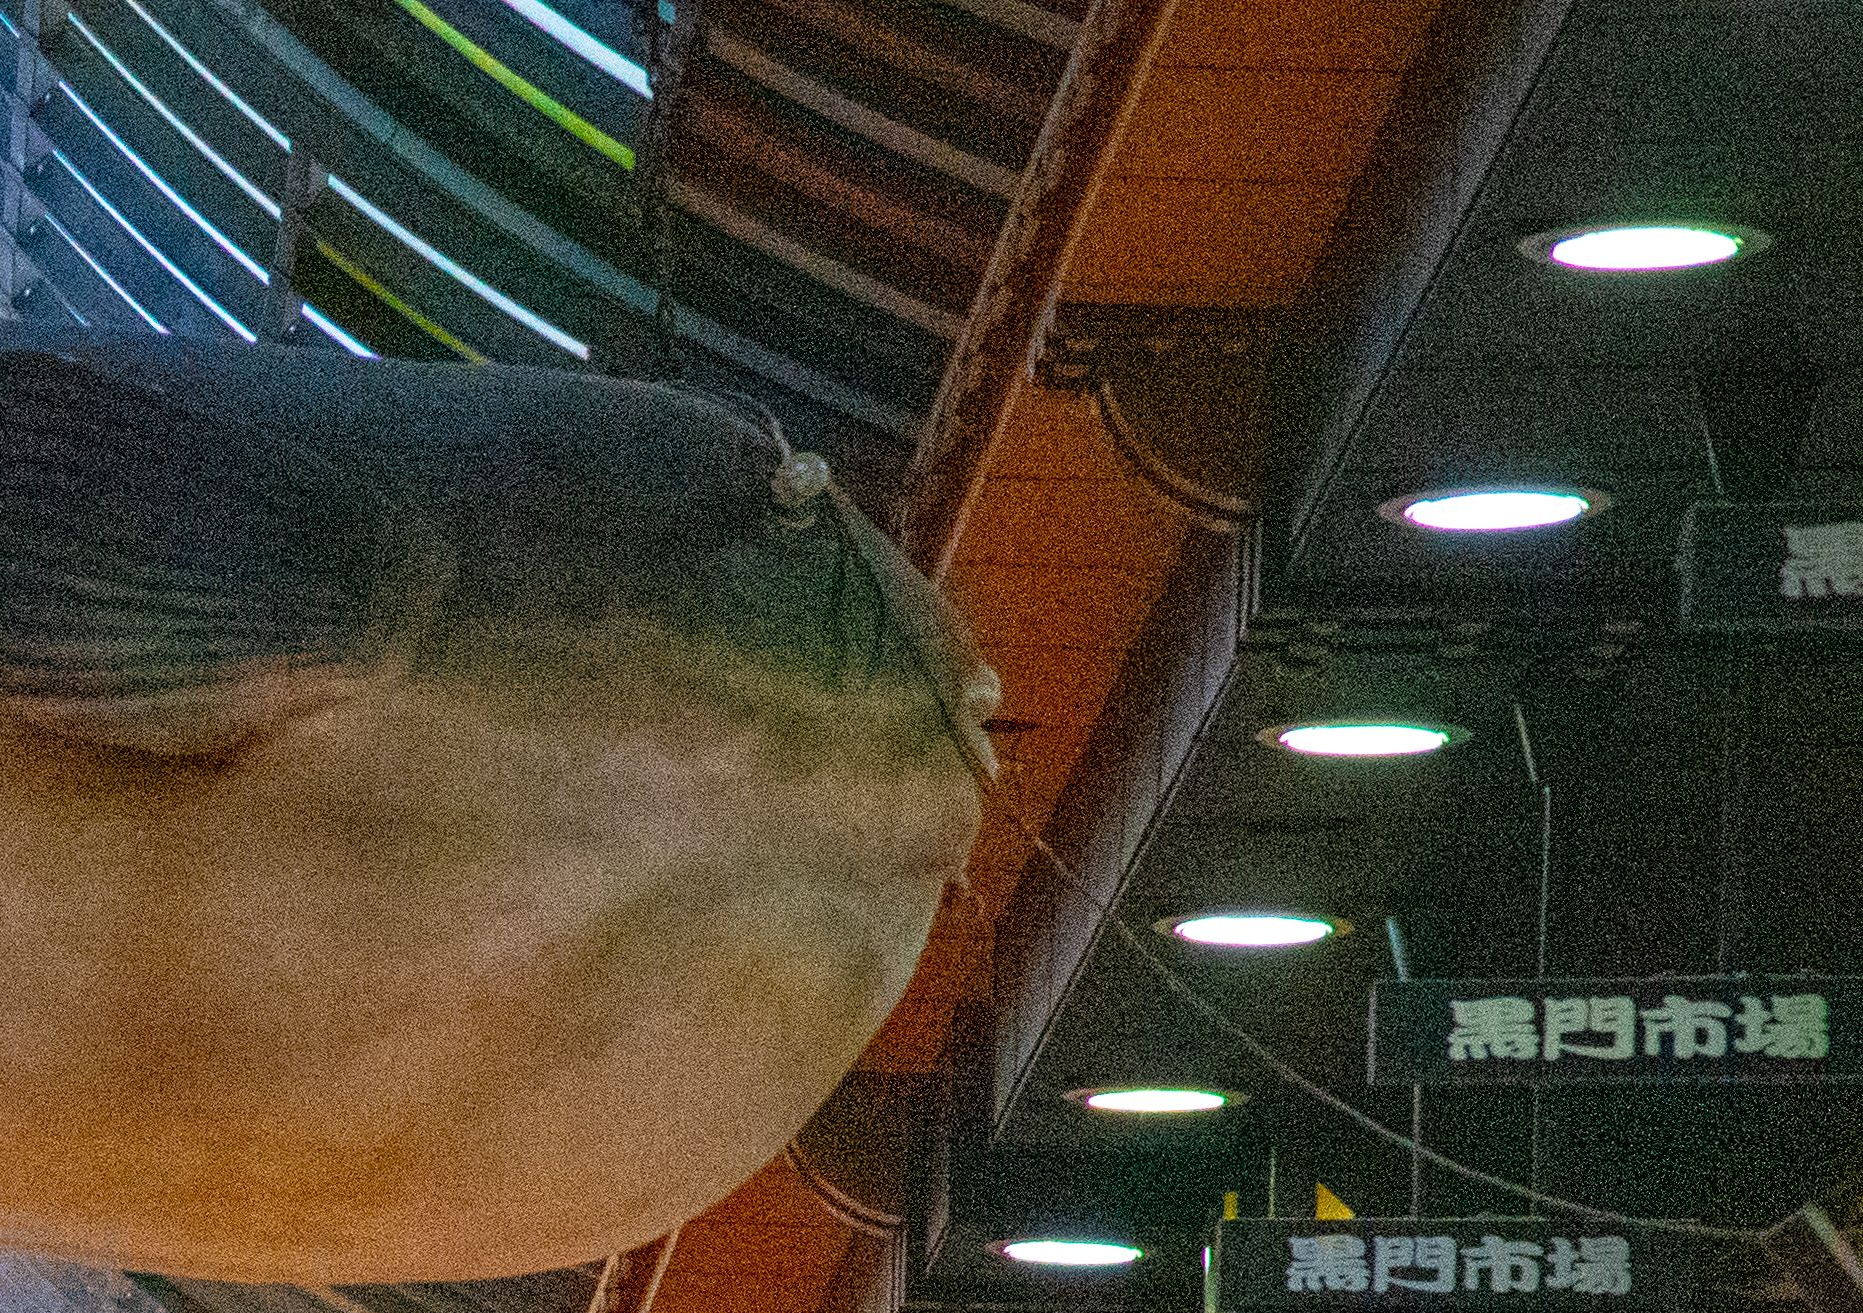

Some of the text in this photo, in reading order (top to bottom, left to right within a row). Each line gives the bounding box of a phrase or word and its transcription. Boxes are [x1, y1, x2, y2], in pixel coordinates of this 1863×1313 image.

[1447, 996, 1829, 1061] 黒門市場
[1285, 1235, 1633, 1296] 黒門市場
